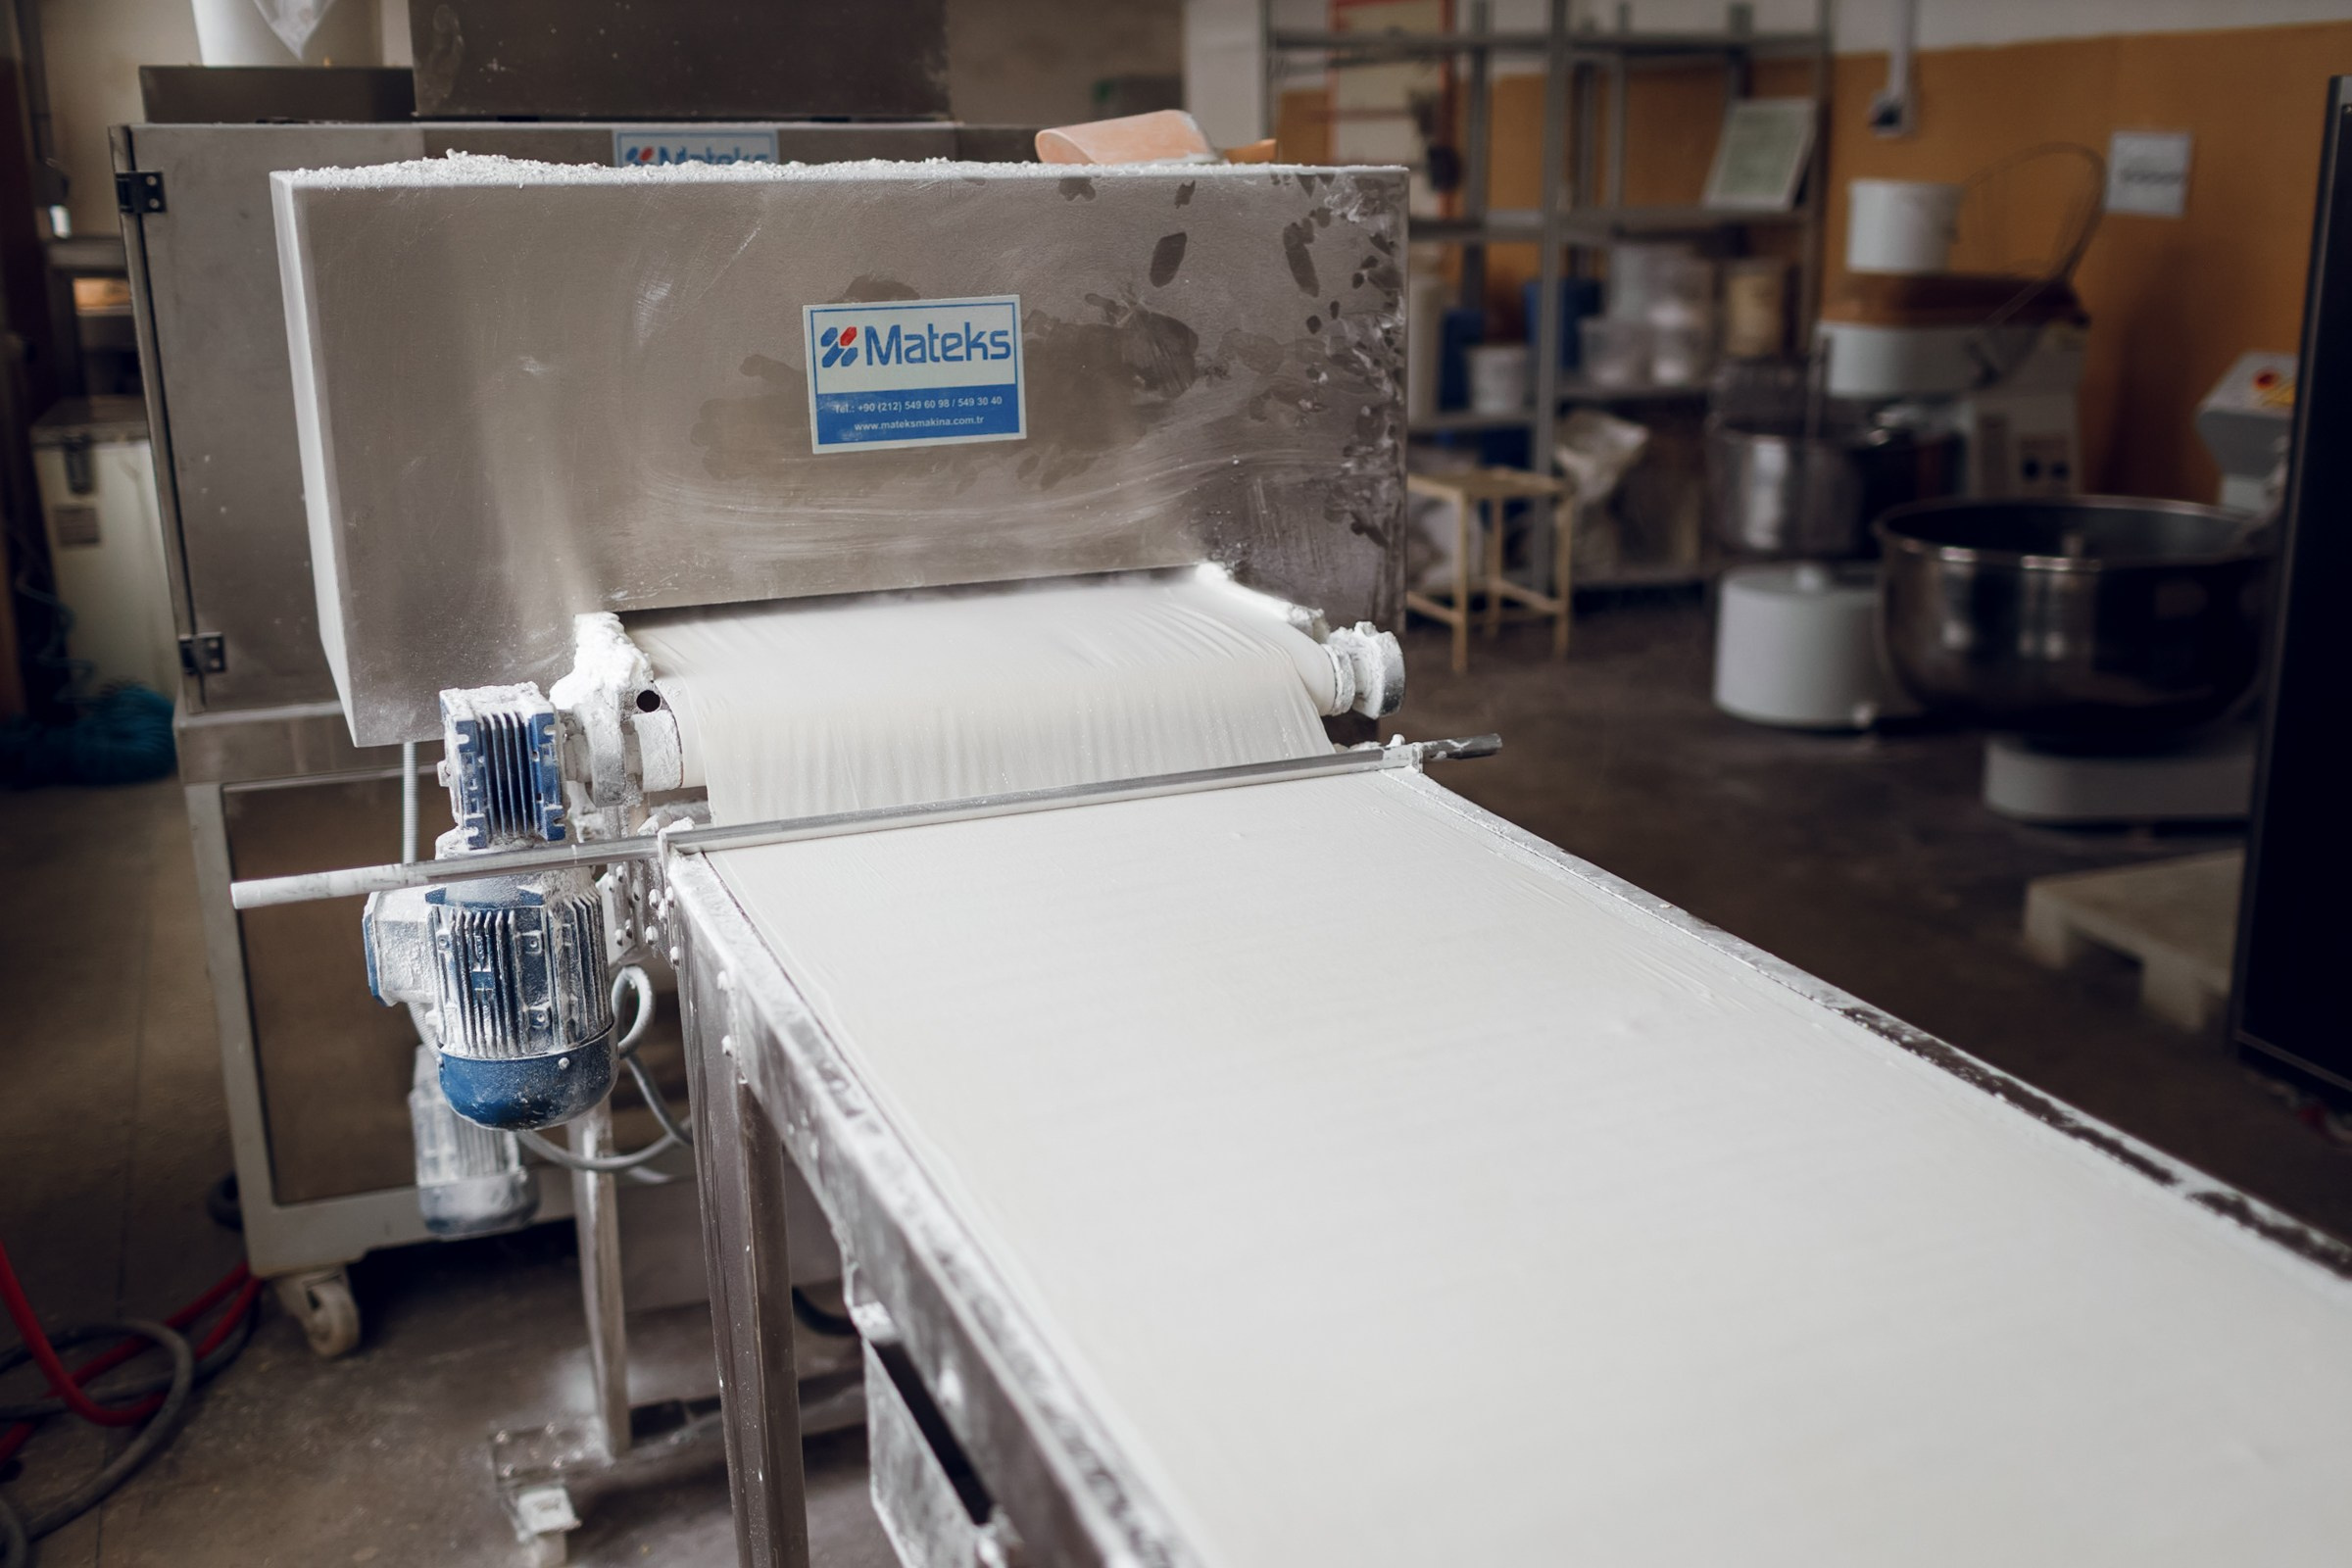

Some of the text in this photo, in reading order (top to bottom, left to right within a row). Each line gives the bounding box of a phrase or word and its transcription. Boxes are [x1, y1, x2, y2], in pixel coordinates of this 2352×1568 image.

[864, 321, 1011, 366] Mateks
[858, 403, 875, 413] +90
[878, 400, 902, 413] (212)
[905, 399, 921, 410] 549
[924, 398, 936, 409] 60
[938, 397, 950, 408] 98
[958, 396, 975, 408] 549
[977, 395, 989, 407] 30
[991, 394, 1003, 405] 40
[855, 416, 984, 431] www.mateksmakina.com.tr
